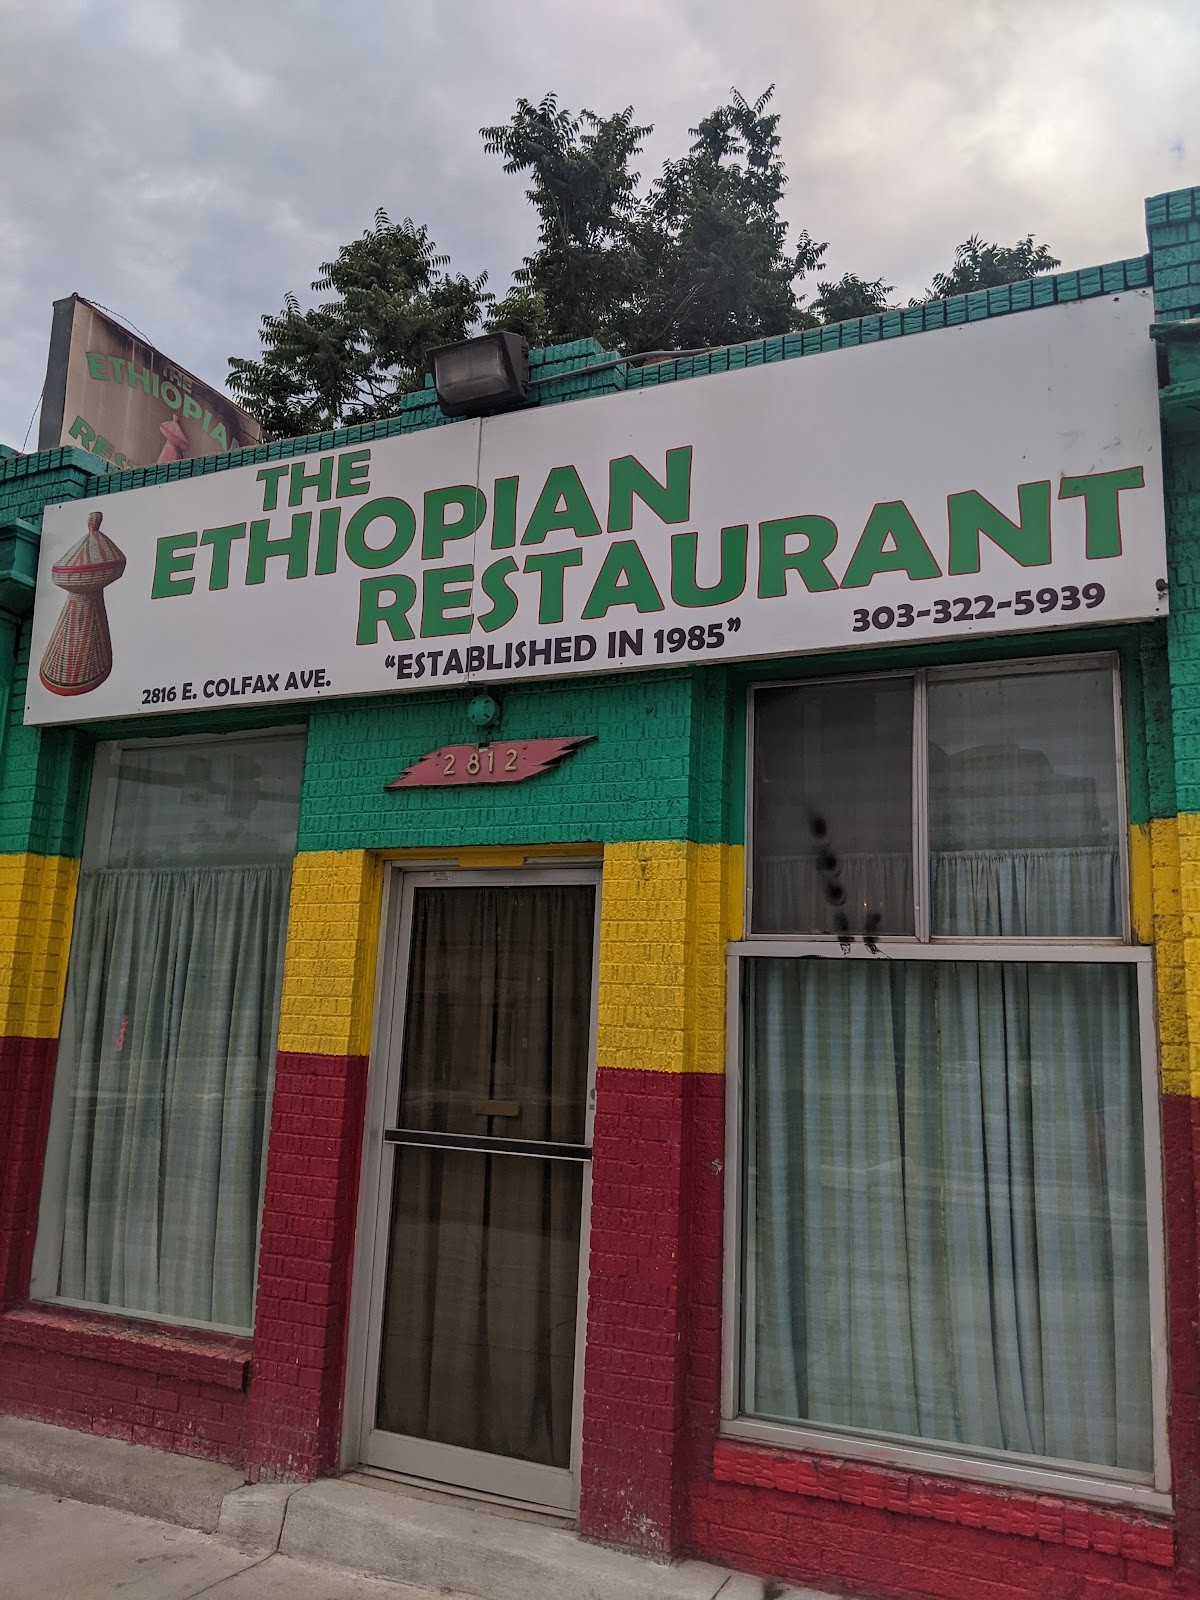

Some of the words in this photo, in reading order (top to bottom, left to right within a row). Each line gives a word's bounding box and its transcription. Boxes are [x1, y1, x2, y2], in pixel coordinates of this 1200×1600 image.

[86, 352, 239, 452] ETHIOPIA
[256, 449, 371, 511] THE
[151, 445, 693, 600] ETHIOPIAN
[356, 465, 1145, 646] RESTAURANT
[852, 582, 1106, 632] 303-322-5939
[385, 634, 597, 680] “ESTABLISHED
[607, 628, 645, 659] IN
[653, 616, 742, 654] 1985”
[141, 688, 177, 705] 2816
[182, 682, 197, 701] E.
[203, 673, 280, 698] COLFAX
[284, 668, 331, 690] AVE.
[443, 749, 517, 776] 2812
